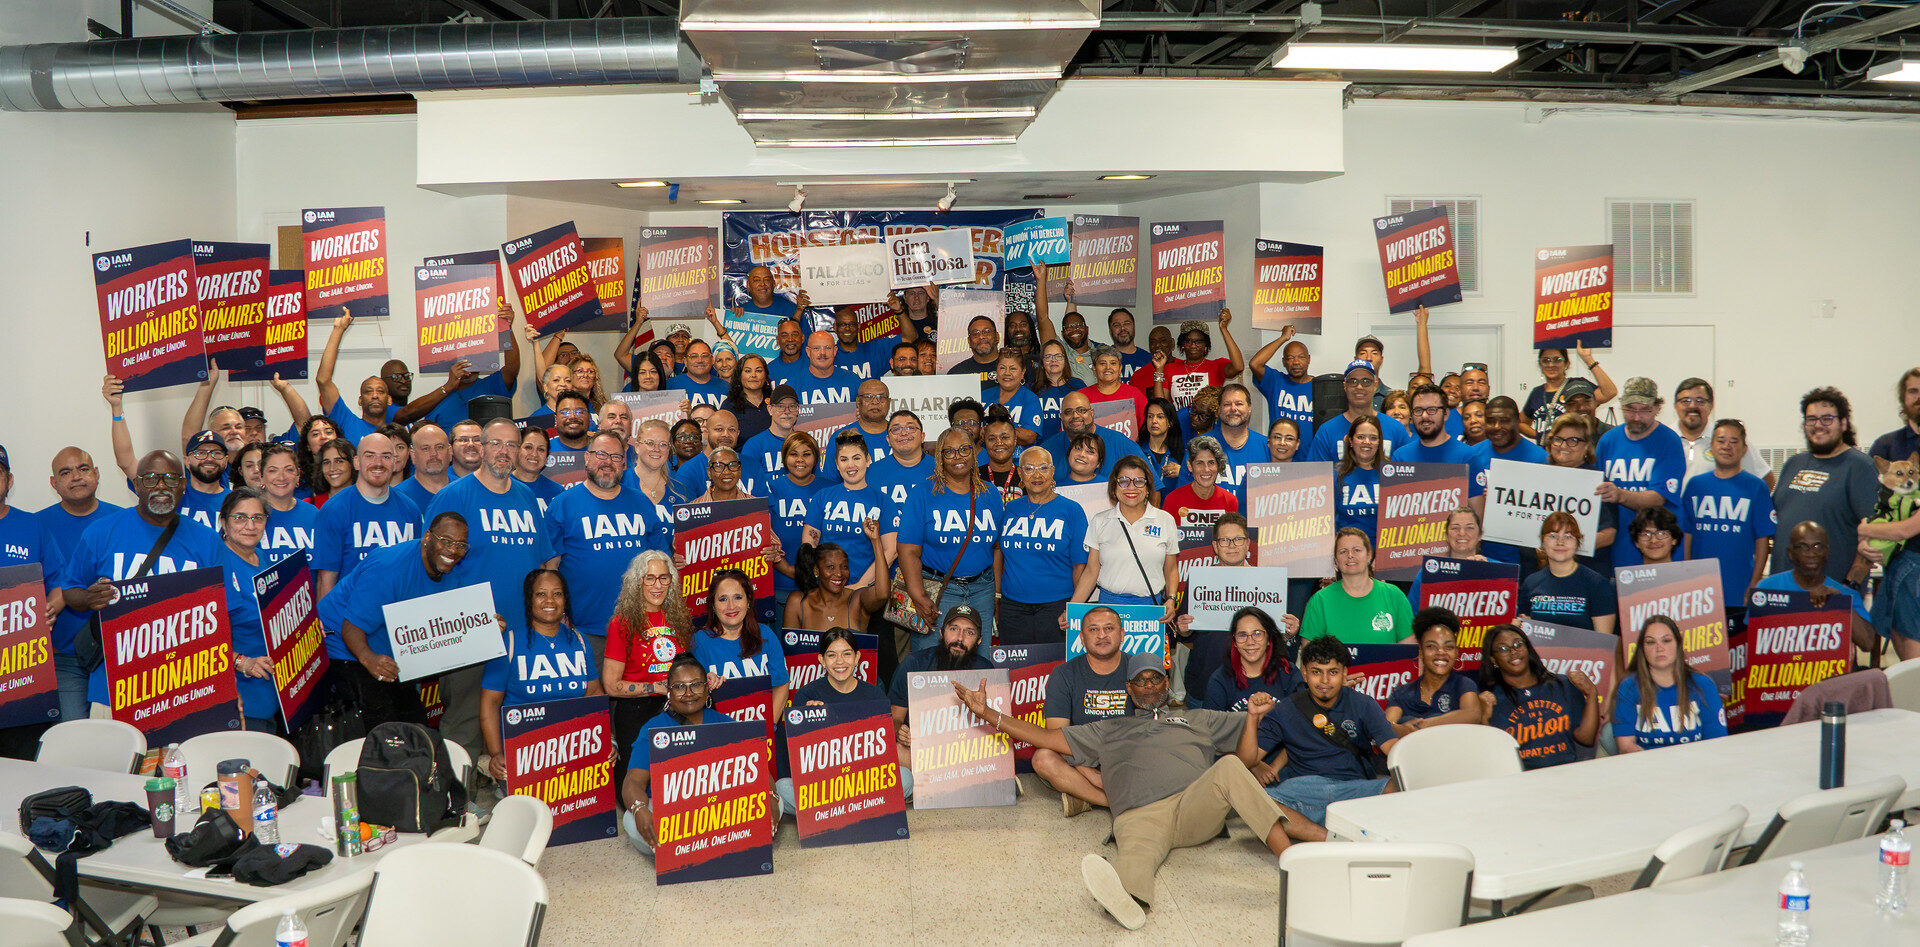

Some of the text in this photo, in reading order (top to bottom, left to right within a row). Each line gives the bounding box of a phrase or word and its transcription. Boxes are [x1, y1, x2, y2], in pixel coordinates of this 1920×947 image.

[1387, 217, 1403, 225] IAM
[311, 229, 379, 262] WORKERS
[516, 238, 532, 248] IAM
[893, 239, 930, 257] Gina
[1006, 228, 1064, 245] MI UNIÓN MI DERECHO
[1078, 235, 1133, 257] WORKERS
[1386, 226, 1445, 263] WORKERS
[112, 254, 132, 264] IAM
[646, 244, 702, 270] WORKERS
[1007, 238, 1066, 261] MI VOTO
[1158, 241, 1218, 270] WORKERS
[308, 257, 384, 290] BILLIONAIRES
[519, 242, 578, 288] WORKERS
[806, 263, 884, 279] TALARICO
[895, 255, 968, 277] Hinojosa.
[1073, 258, 1135, 279] BILLIONAIRES
[1260, 264, 1318, 282] WORKERS
[1387, 250, 1453, 288] BILLIONAIRES
[524, 265, 588, 314] BILLIONAIRES
[643, 268, 706, 293] BILLIONAIRES
[1155, 266, 1222, 295] BILLIONAIRES
[1541, 265, 1608, 296] WORKERS
[108, 269, 188, 321] WORKERS
[424, 287, 490, 318] WORKERS
[1255, 287, 1320, 304] BILLIONAIRES
[1536, 292, 1611, 323] BILLIONAIRES
[108, 305, 197, 358] BILLIONAIRES
[421, 314, 495, 346] BILLIONAIRES
[725, 320, 732, 328] MI
[752, 324, 760, 333] MI
[760, 324, 778, 335] DEREC
[123, 340, 187, 367] ONE IAM. ONE UNION.
[1176, 375, 1203, 383] ONE
[1278, 390, 1313, 413] IAM
[1281, 411, 1313, 422] UNION
[1606, 458, 1655, 482] IAM
[692, 507, 711, 516] IAM
[1255, 486, 1327, 518] WORKERS
[1386, 488, 1461, 518] WORKERS
[1495, 487, 1591, 516] TALARICO
[1692, 496, 1751, 522] IAM
[480, 509, 536, 533] IAM
[582, 514, 645, 539] IAM
[933, 509, 996, 532] IAM
[1187, 513, 1220, 523] ONE
[1515, 511, 1531, 519] FOR
[353, 521, 414, 547] IAM
[1002, 517, 1064, 540] IAM
[1696, 523, 1741, 533] UNION
[6, 544, 29, 556] IAM
[492, 536, 534, 545] UNION
[594, 540, 641, 551] UNION
[685, 523, 763, 566] WORKERS
[1004, 541, 1056, 551] UNION
[1440, 561, 1461, 570] IAM
[122, 583, 148, 595] IAM
[265, 571, 279, 585] IAM
[1193, 586, 1282, 606] Gina Hinojosa.
[1202, 603, 1220, 611] Texas
[1767, 594, 1789, 603] IAM
[269, 581, 312, 650] WORKERS
[1070, 620, 1159, 632] MI DERECHO
[116, 601, 218, 665] WORKERS
[395, 612, 492, 645] Gina Hinojosa.
[1755, 622, 1842, 655] WORKERS
[275, 618, 322, 692] BILLIONAIRES
[409, 644, 429, 655] Texas
[429, 635, 463, 650] Governor
[1121, 635, 1160, 654] OTO
[115, 643, 228, 711] BILLIONAIRES
[518, 651, 587, 681] IAM
[648, 663, 672, 672] MEMB
[1748, 660, 1846, 689] BILLIONAIRES
[9, 675, 34, 689] UNION.
[527, 681, 587, 694] UNION
[135, 685, 215, 721] ONE IAM. ONE UNION.
[523, 707, 545, 718] IAM
[805, 709, 827, 719] IAM
[672, 731, 696, 742] IAM
[517, 725, 602, 777] WORKERS
[800, 728, 887, 774] WORKERS
[915, 731, 1009, 773] BILLIONAIRES
[1519, 748, 1542, 758] UPAT
[1543, 745, 1556, 754] DC
[664, 753, 758, 804] WORKERS
[799, 763, 896, 811] BILLIONAIRES
[561, 796, 598, 814] ONE UNION.
[815, 797, 885, 821] ONE IAM. ONE UNION.
[659, 792, 766, 844] BILLIONAIRES
[676, 829, 751, 855] ONE IAM. ONE UNION.
